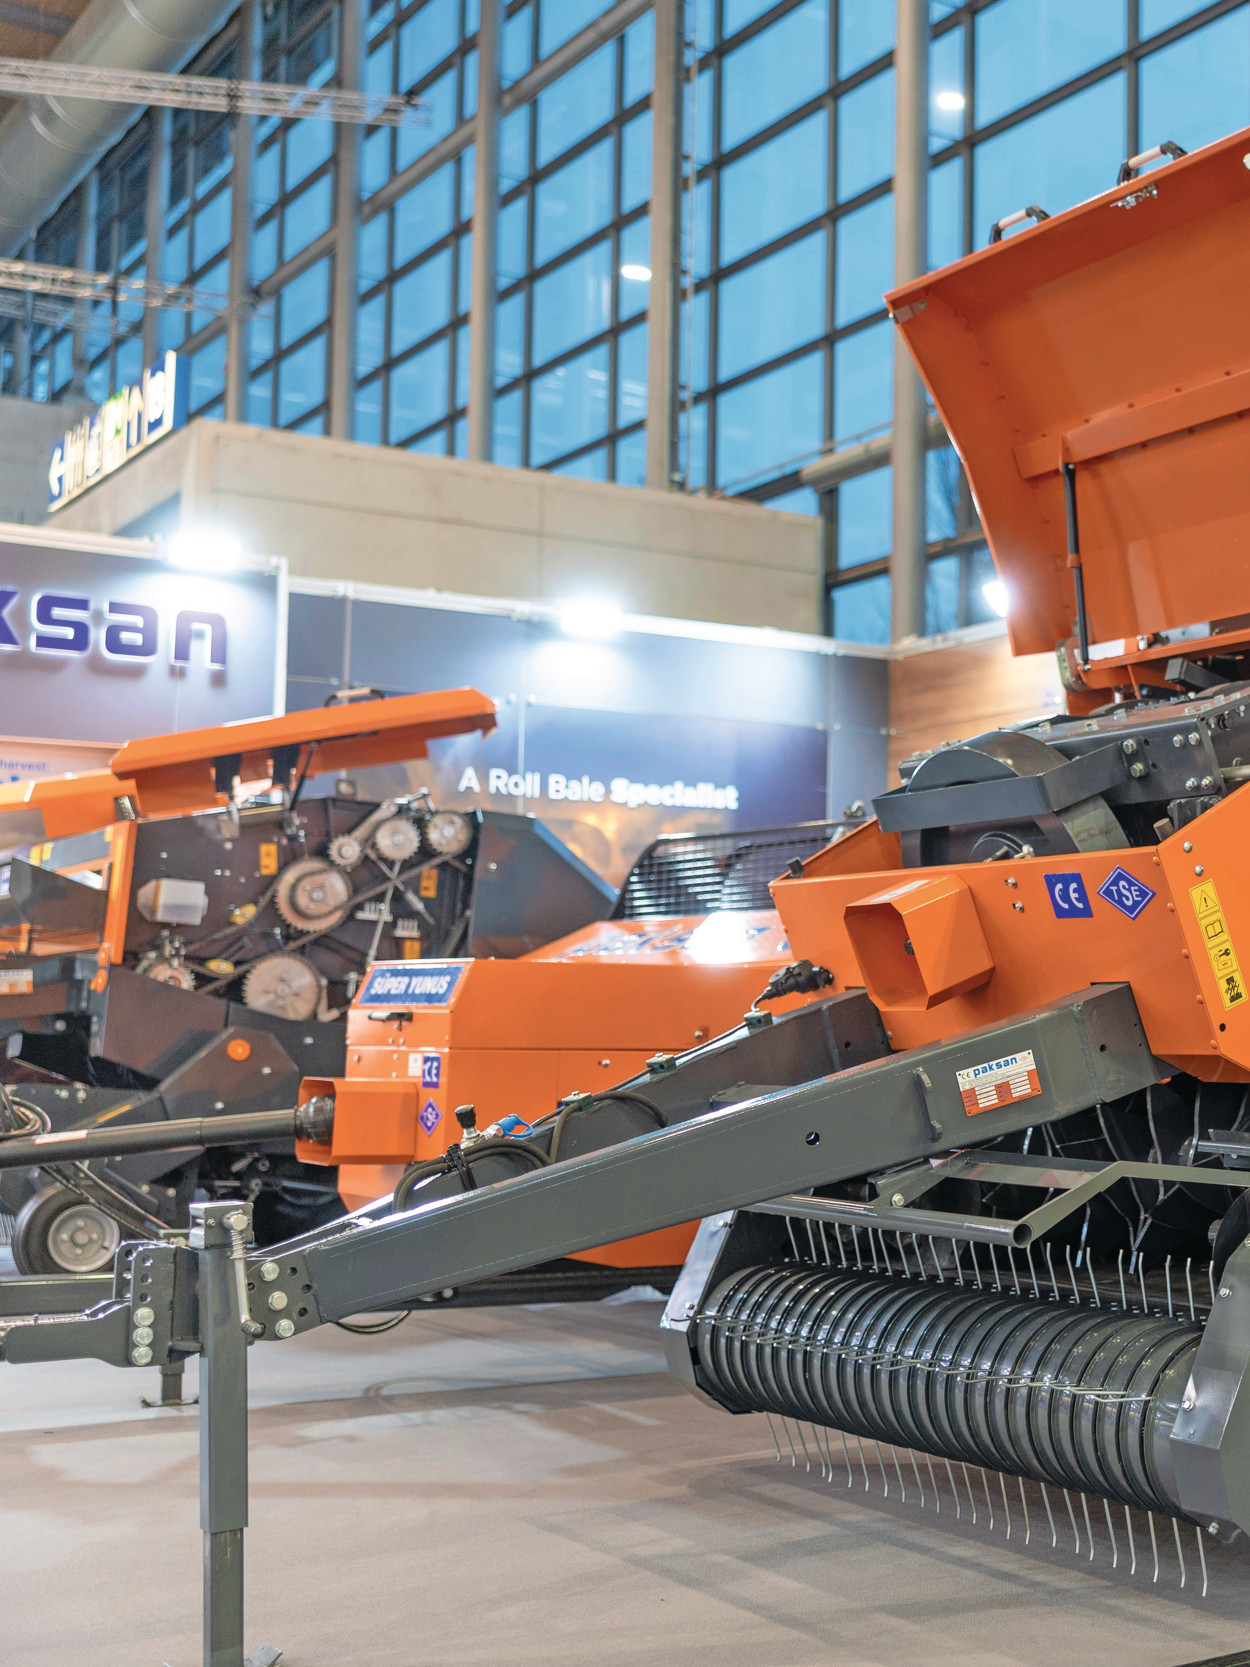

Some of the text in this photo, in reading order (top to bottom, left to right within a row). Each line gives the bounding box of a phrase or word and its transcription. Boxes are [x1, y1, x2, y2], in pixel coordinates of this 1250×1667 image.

[457, 766, 739, 810] A Roll Bale Specialist
[1055, 882, 1084, 909] CE
[1109, 880, 1142, 906] TSE
[370, 972, 452, 995] SÜPER YUNUS
[973, 1056, 1018, 1078] paksan
